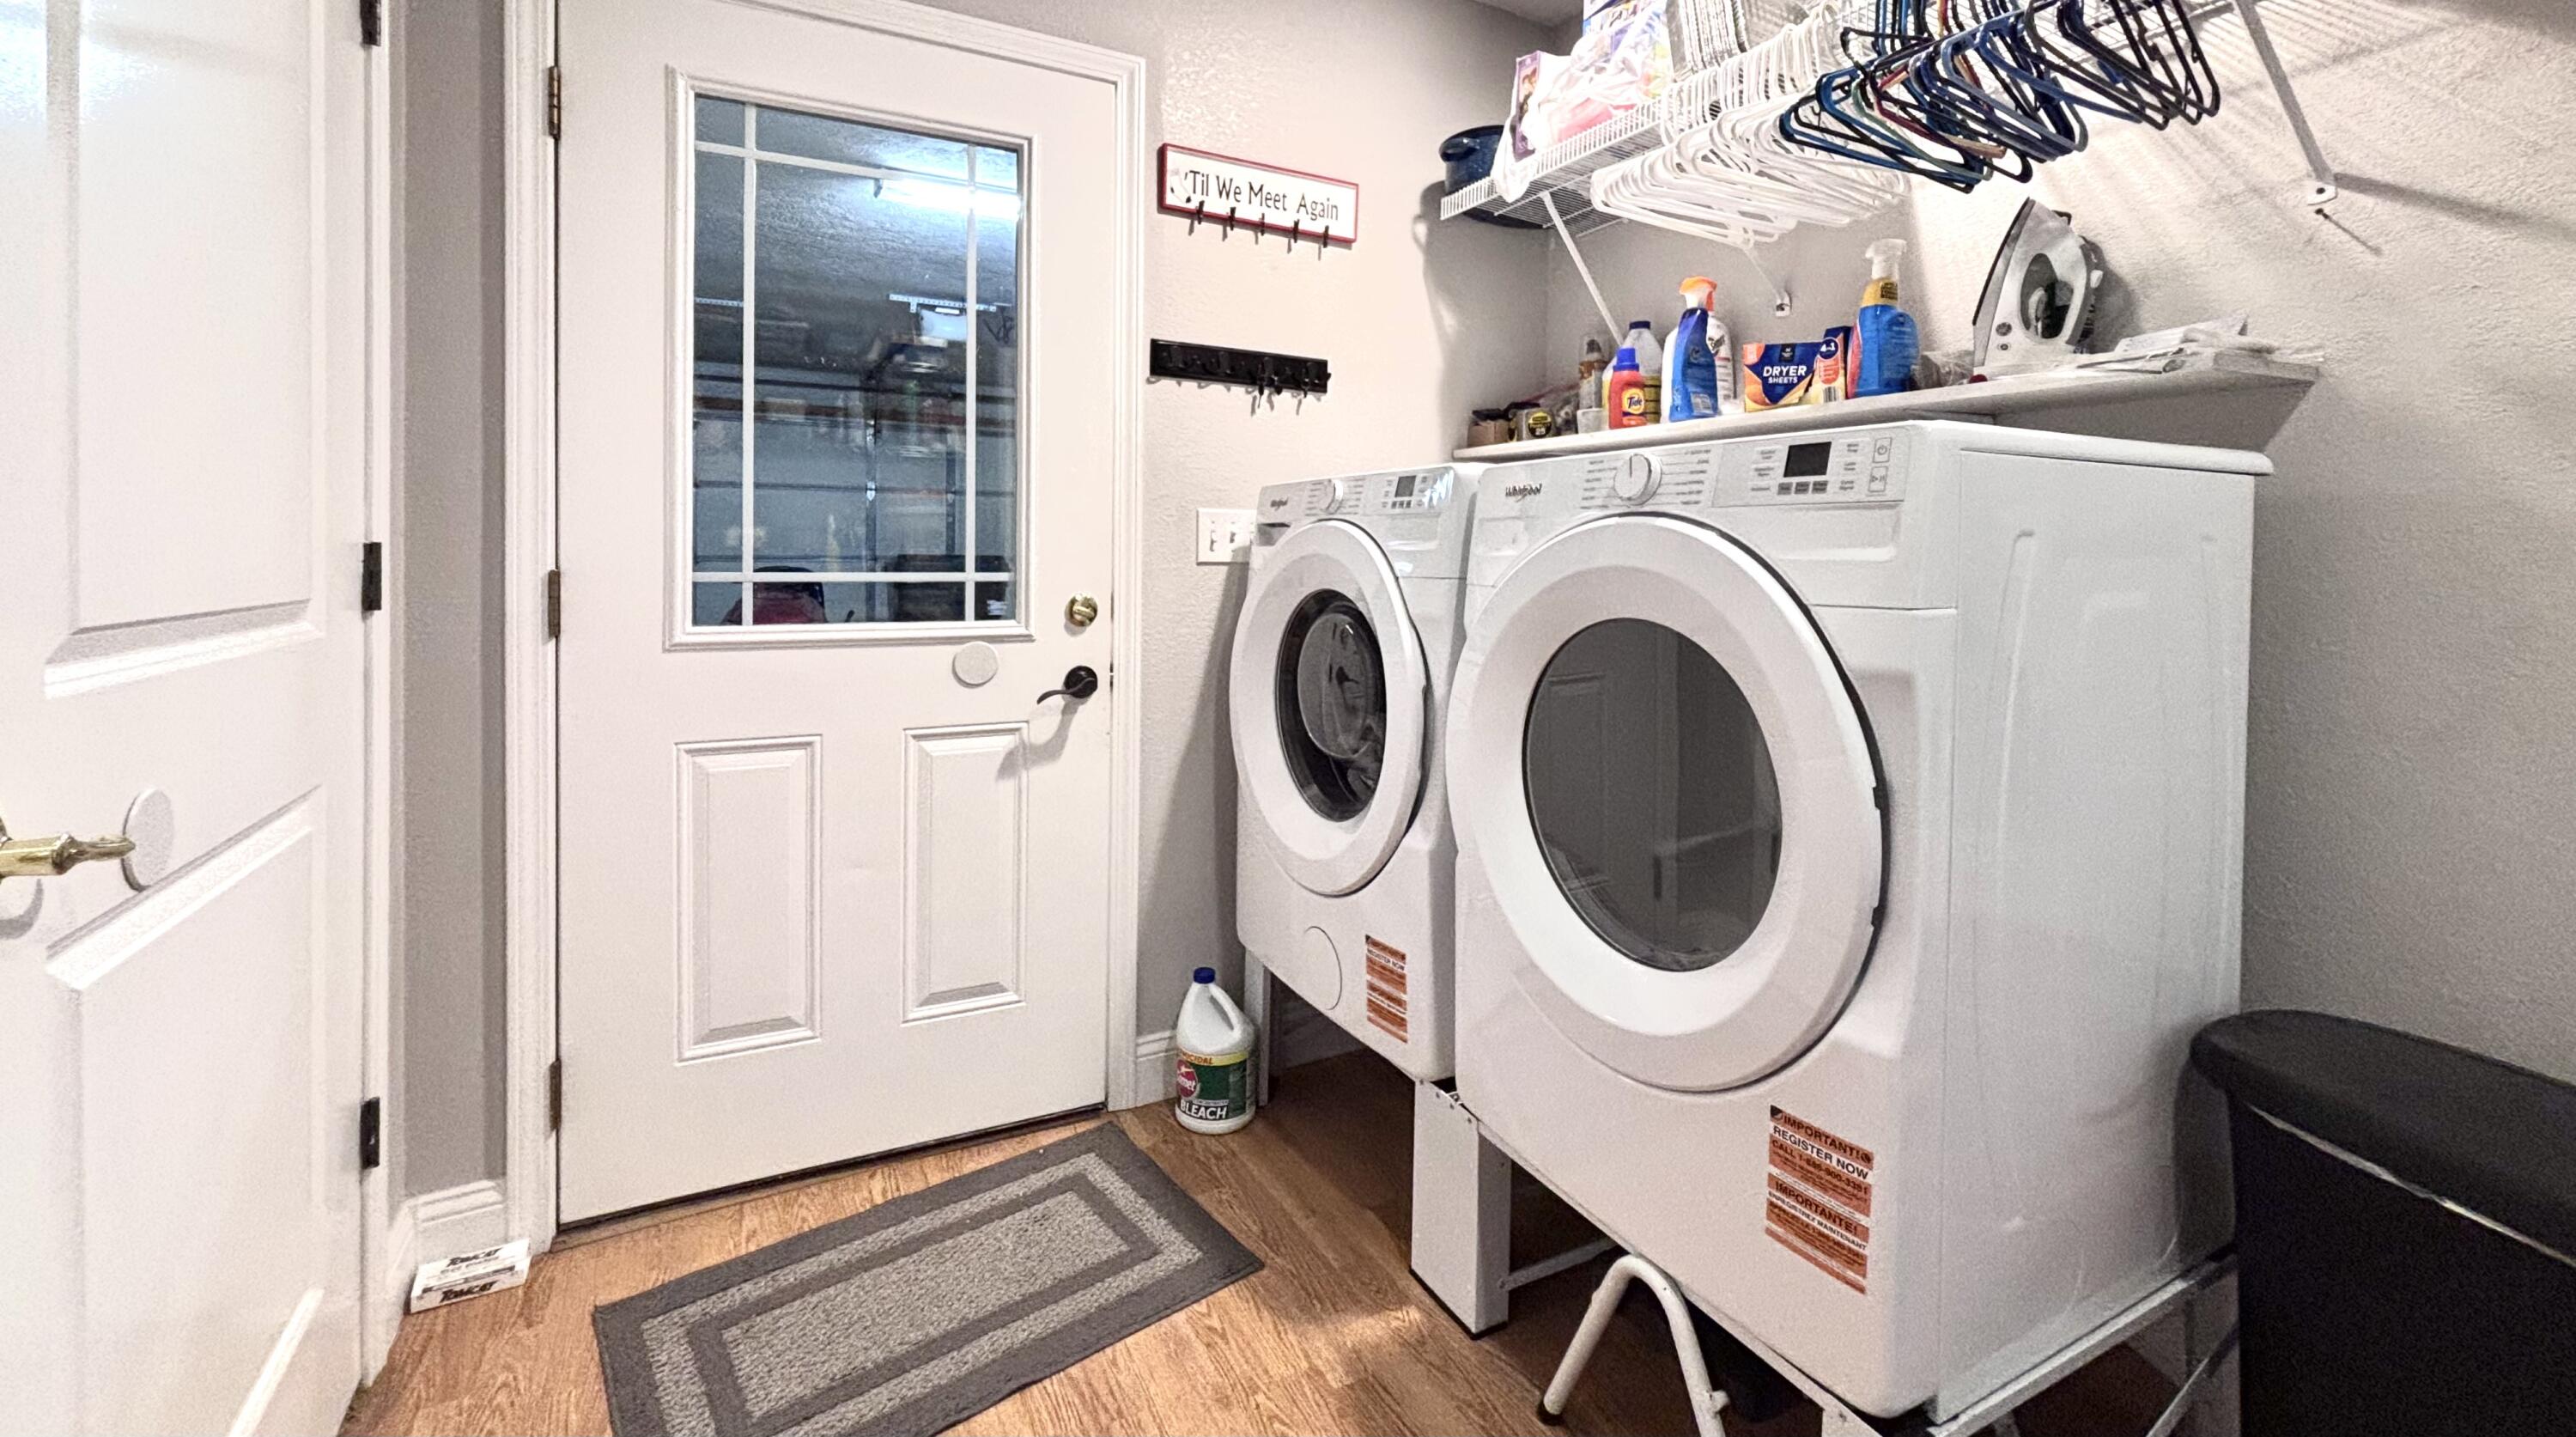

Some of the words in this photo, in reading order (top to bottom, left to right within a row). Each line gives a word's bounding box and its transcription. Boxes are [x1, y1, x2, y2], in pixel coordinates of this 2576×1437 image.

[1216, 175, 1242, 203] We
[1248, 181, 1288, 211] Meet
[1296, 193, 1339, 221] Again
[1763, 365, 1807, 377] DRYER
[1627, 396, 1643, 409] Tide
[1181, 1099, 1228, 1119] BLEACH
[1783, 1113, 1861, 1160] IMPORTANT!
[1772, 1140, 1796, 1159] CALL
[1773, 1125, 1832, 1164] REGISTER
[1837, 1157, 1868, 1179] NOW
